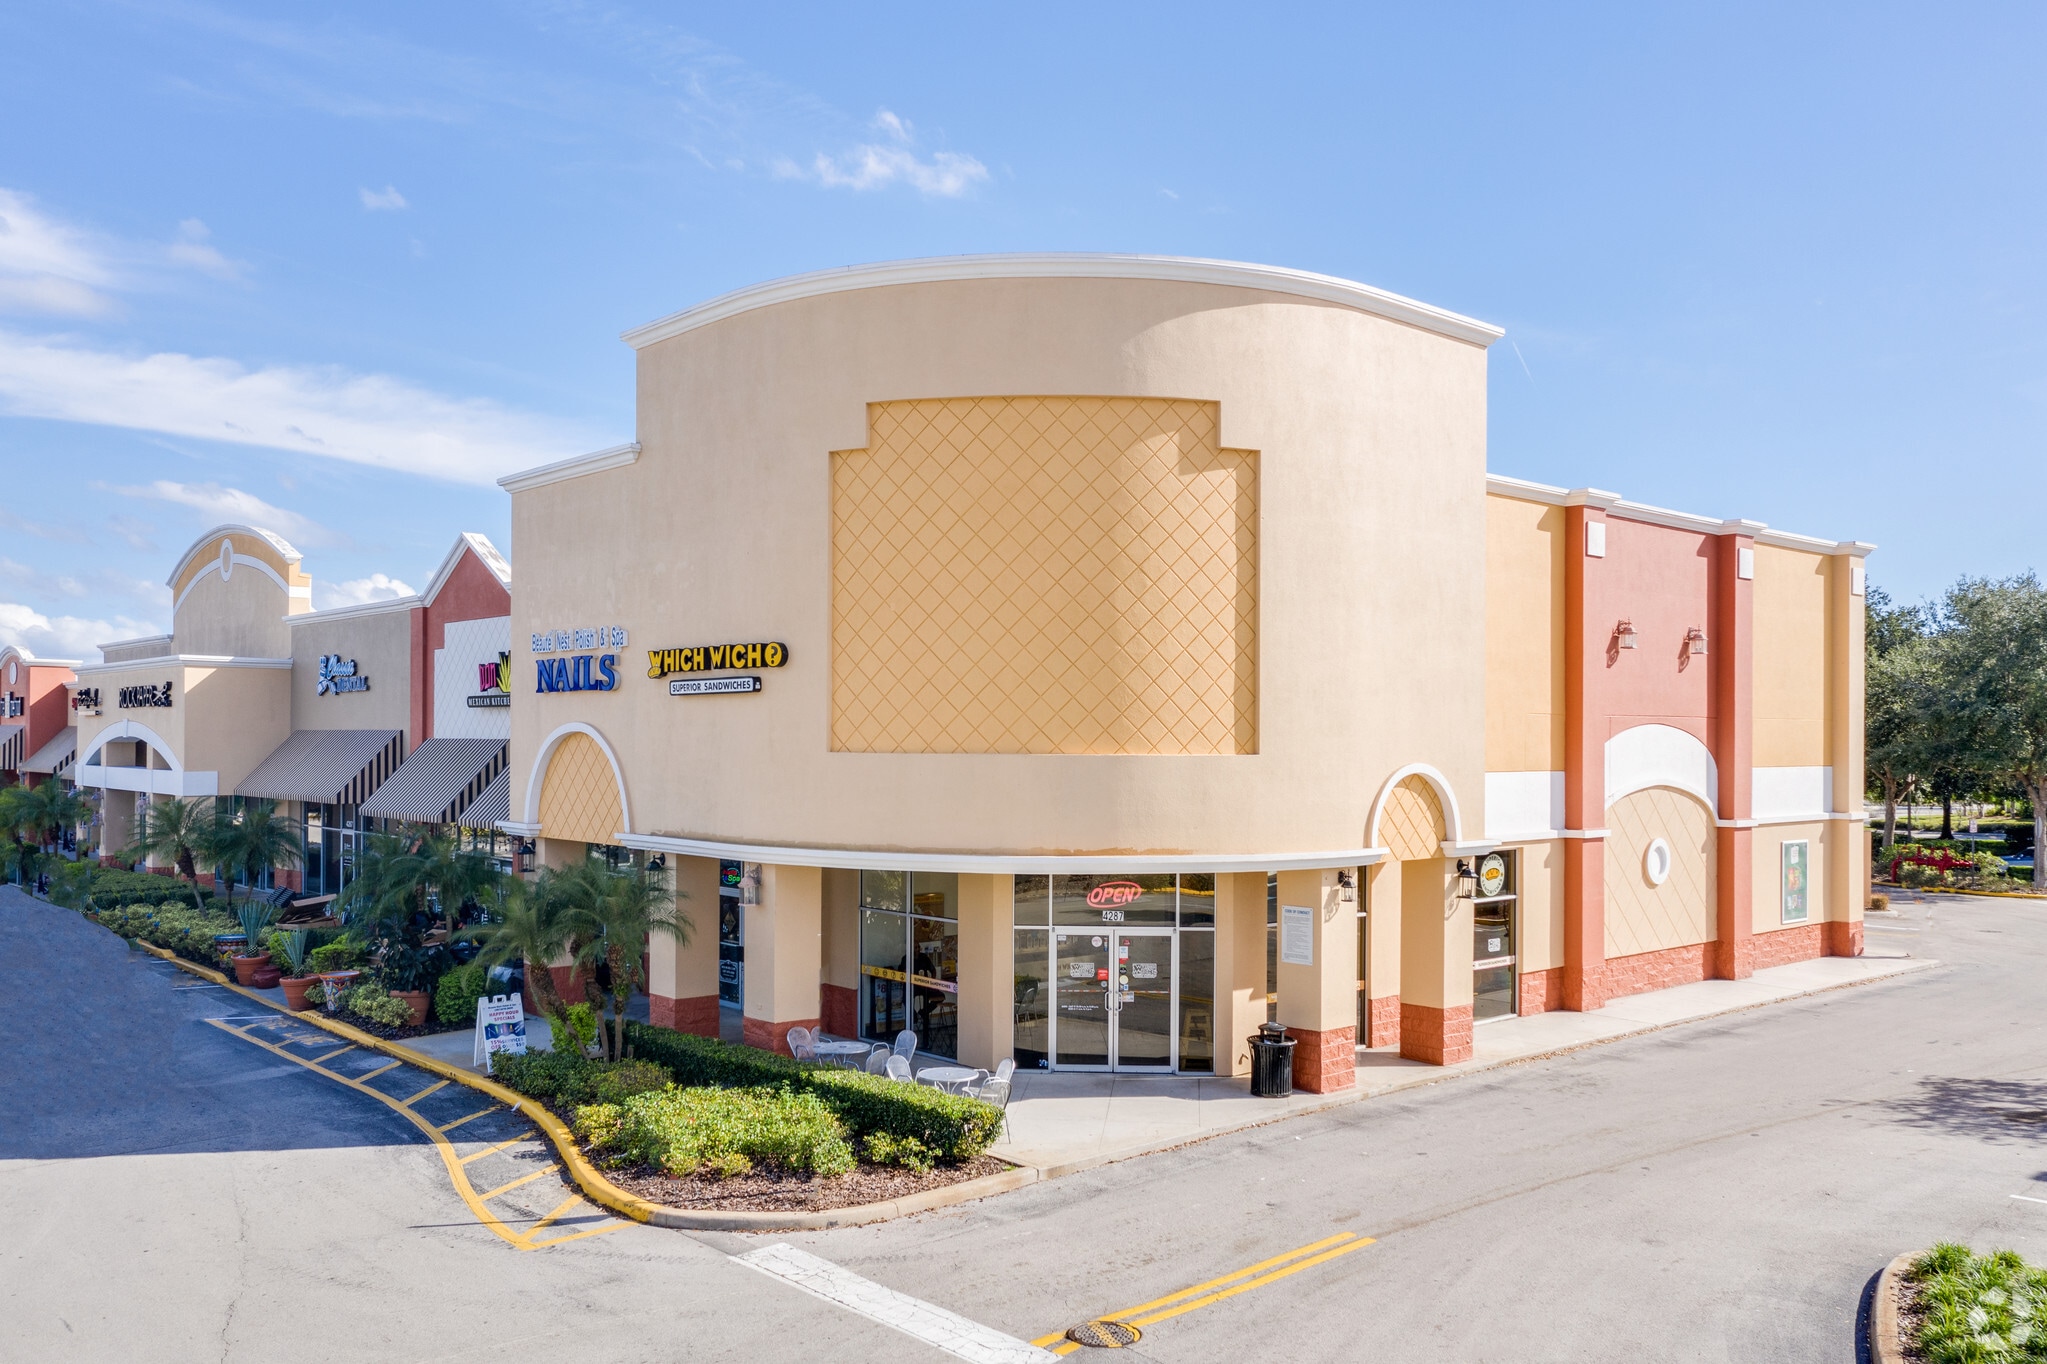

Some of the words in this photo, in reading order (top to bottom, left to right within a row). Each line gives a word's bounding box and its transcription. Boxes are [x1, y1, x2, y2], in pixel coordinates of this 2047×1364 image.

[556, 631, 570, 649] Nest
[575, 629, 594, 649] Polish
[611, 626, 624, 651] Spa
[648, 647, 705, 673] WHICH
[709, 643, 762, 669] WICH
[535, 653, 616, 693] NAILS
[672, 683, 702, 692] SUPERIOR
[704, 680, 751, 691] SANDWICHES
[1090, 887, 1136, 903] OPEN
[1102, 911, 1124, 921] 4287
